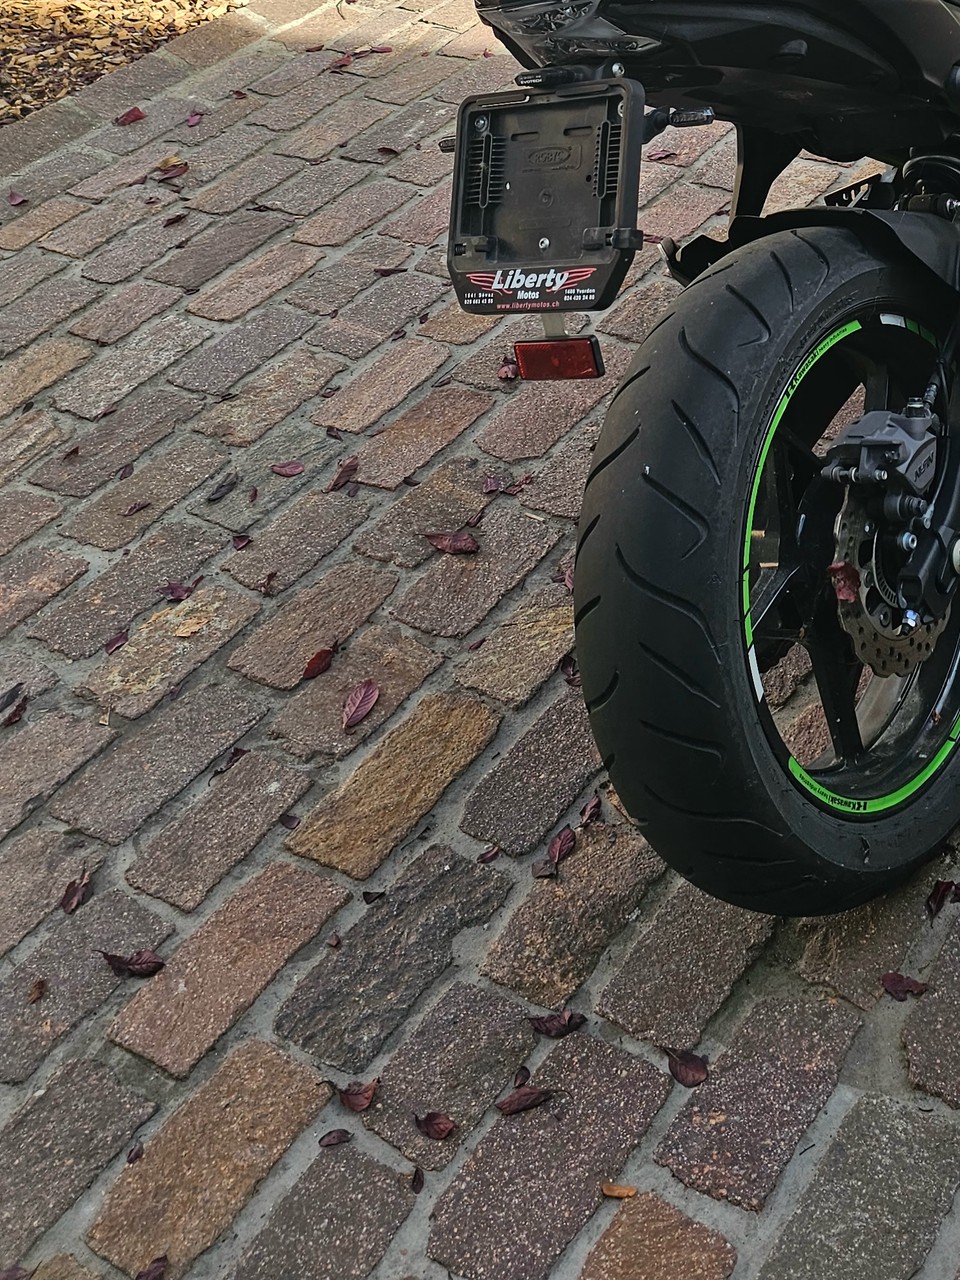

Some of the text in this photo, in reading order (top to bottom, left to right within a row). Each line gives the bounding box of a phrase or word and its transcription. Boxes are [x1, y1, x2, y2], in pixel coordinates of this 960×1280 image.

[491, 269, 569, 290] Liberty
[516, 290, 540, 300] Motos
[496, 301, 560, 310] www.libertymotos.ch
[794, 349, 819, 383] Kawasaki
[829, 797, 856, 811] Kawasaki
